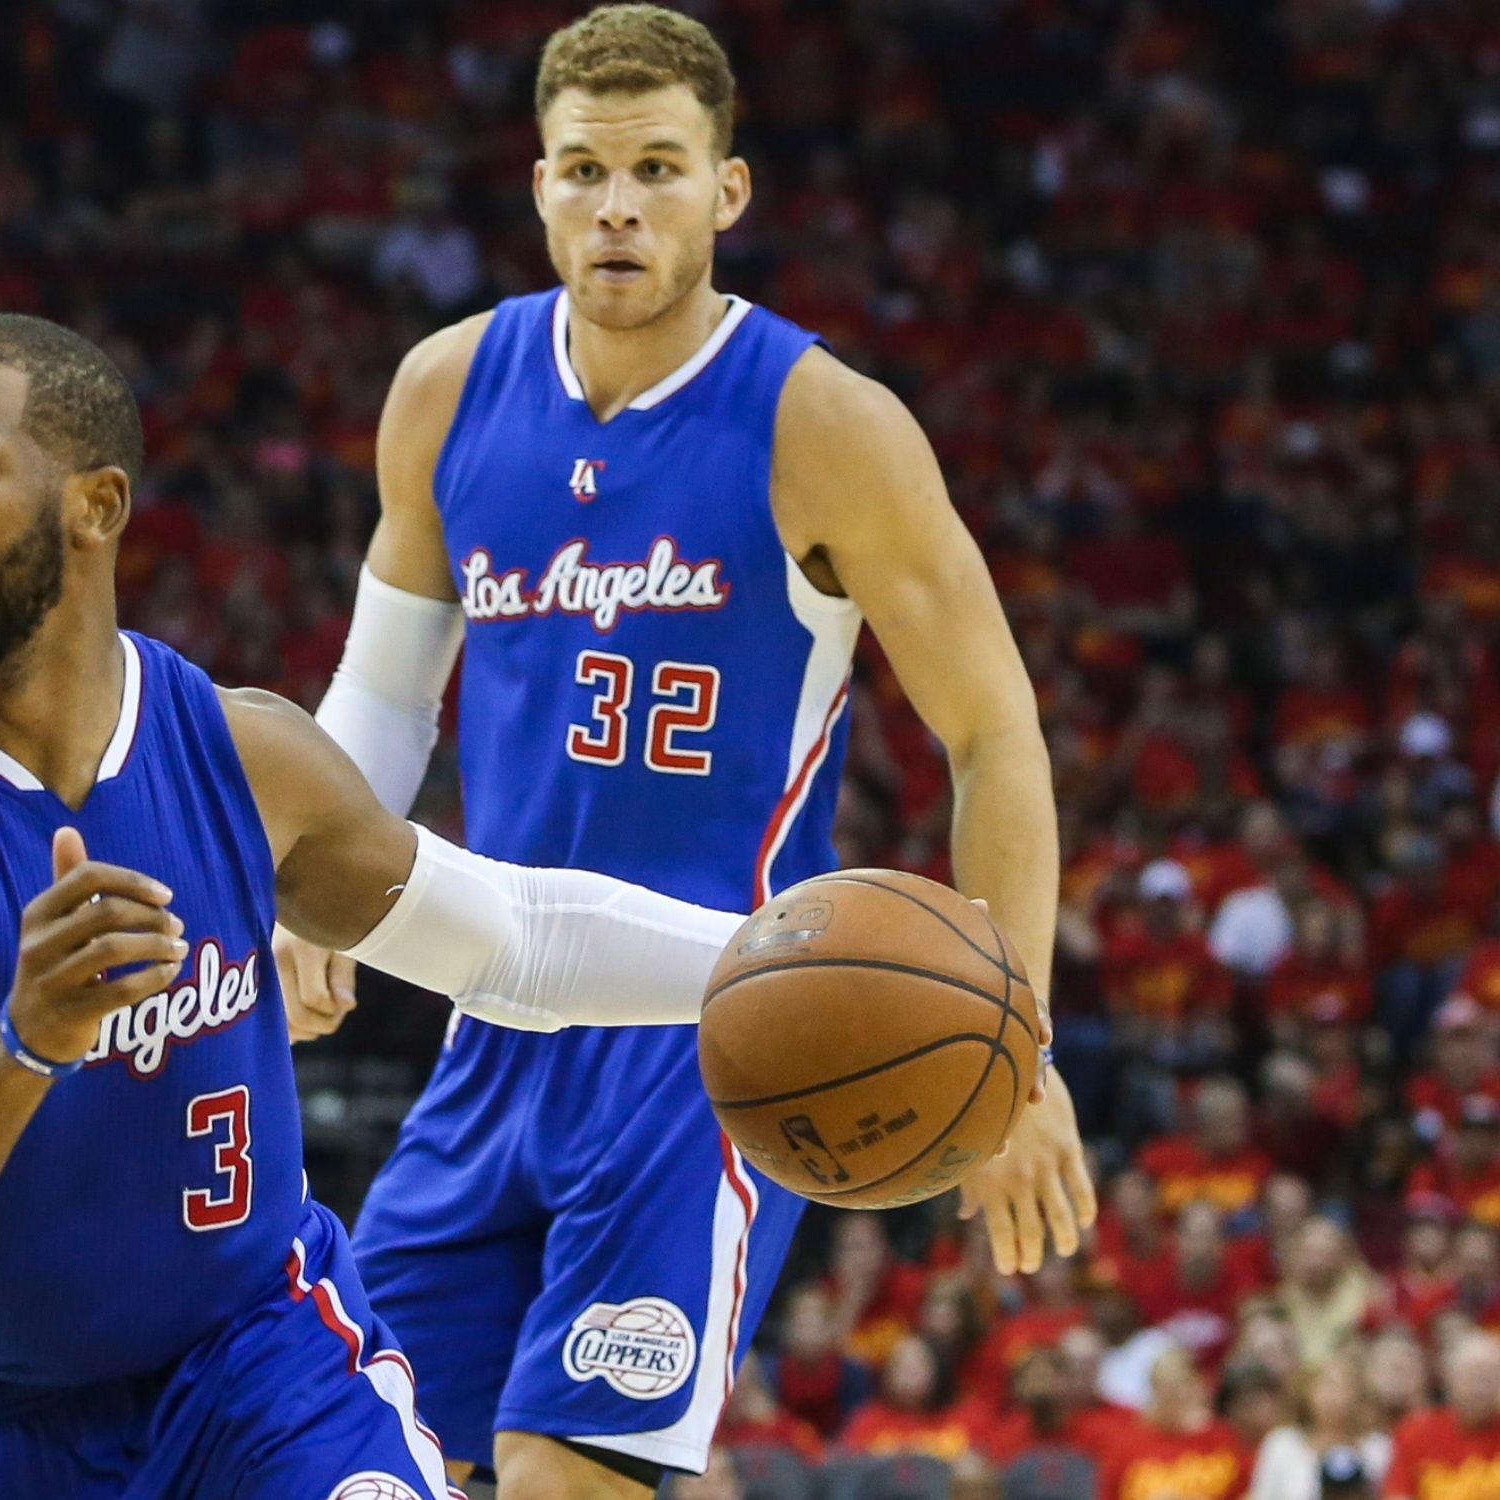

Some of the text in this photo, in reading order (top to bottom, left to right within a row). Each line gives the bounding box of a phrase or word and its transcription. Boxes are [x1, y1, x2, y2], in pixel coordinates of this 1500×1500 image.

[461, 536, 726, 632] Los Angeles
[565, 648, 721, 777] 32
[82, 939, 260, 1077] ngeles
[182, 1083, 253, 1233] 3
[570, 1327, 680, 1374] CLIPPERS
